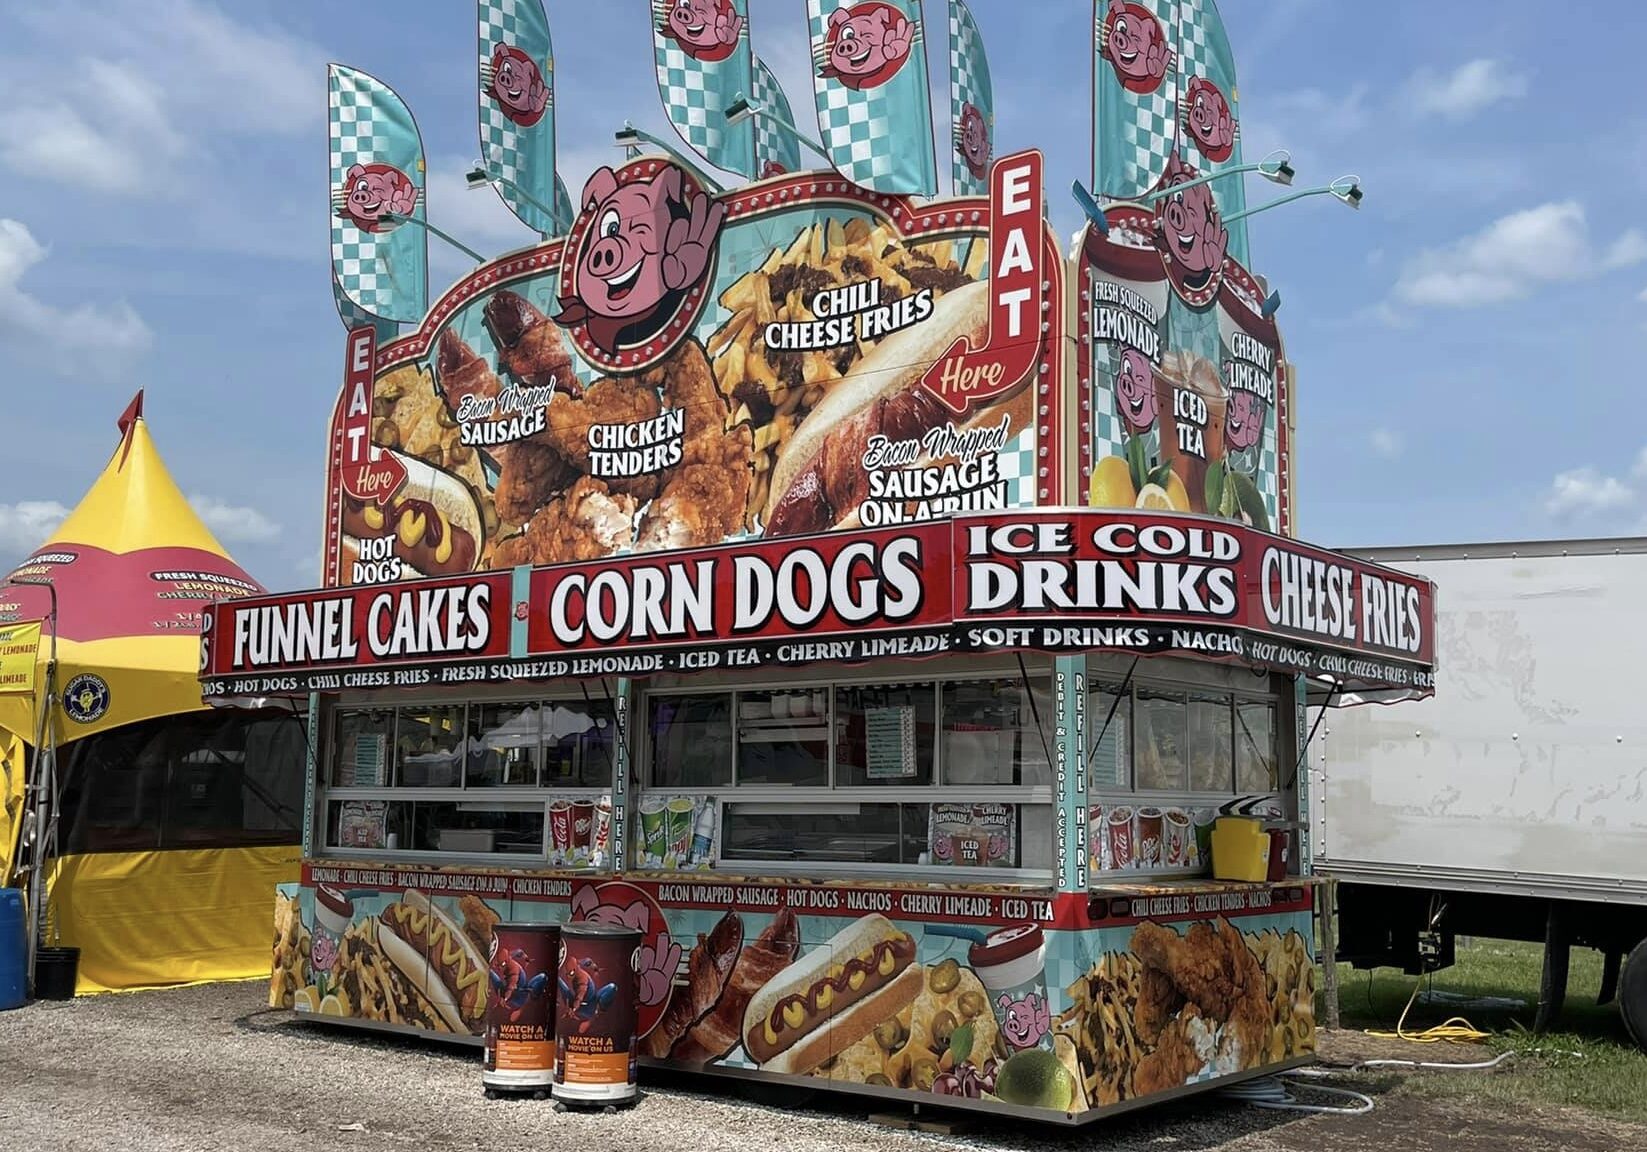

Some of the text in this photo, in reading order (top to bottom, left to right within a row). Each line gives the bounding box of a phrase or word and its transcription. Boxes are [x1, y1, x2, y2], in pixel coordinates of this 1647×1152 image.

[998, 165, 1033, 336] EAT
[812, 278, 881, 317] CHILI
[1096, 282, 1156, 325] FRESH SQUEEZED
[764, 289, 932, 348] CHEESE FRIES
[1094, 307, 1160, 365] LEMONADE
[1232, 333, 1271, 373] CHERRY
[940, 357, 1006, 394] Here
[1230, 364, 1272, 404] LIMEADE
[348, 336, 371, 460] EAT
[457, 377, 556, 423] Bacon Wrapped
[1173, 388, 1207, 425] ICED
[461, 408, 546, 445] SAUSAGE
[588, 409, 685, 449] CHICKEN
[864, 414, 1009, 470] Bacon Wrapped
[1176, 422, 1205, 458] TEA
[589, 439, 682, 477] TENDERS
[869, 452, 998, 498] SAUSAGE
[356, 464, 393, 494] Here
[360, 534, 396, 560] HOT
[968, 523, 1240, 560] ICE COLD
[174, 583, 251, 597] LEMONADE
[353, 557, 401, 584] DOGS
[969, 560, 1236, 614] DRINKS
[552, 538, 920, 643] CORN DOGS
[1262, 547, 1421, 652] CHEESE FRIES
[233, 599, 357, 668] FUNNEL
[368, 584, 489, 656] CAKES
[3, 644, 36, 655] LEMONADE
[234, 680, 259, 692] HOT
[262, 678, 297, 691] DOGS
[308, 676, 340, 690] CHILI
[344, 672, 390, 686] CHEESE
[394, 670, 430, 684] FRIES
[442, 666, 486, 681] FRESH
[490, 658, 568, 679] SQUEEZED
[572, 654, 663, 674] LEMONADE
[679, 652, 720, 668] ICED
[727, 650, 760, 666] TEA
[777, 642, 853, 662] CHERRY
[862, 634, 950, 656] LIMEADE
[968, 628, 1034, 646] SOFT
[1043, 628, 1150, 646] DRINKS
[1252, 642, 1279, 660] HOT
[1280, 648, 1312, 667] DOGS
[1319, 654, 1346, 672] CHILI
[1349, 660, 1383, 679] CHEESE
[1384, 666, 1407, 684] FRIES
[1056, 673, 1066, 887] DEBIT & CREDIT ACCEPTED
[1076, 674, 1086, 888] REFILL HERE
[615, 806, 624, 871] HERE
[961, 840, 979, 850] ICED
[962, 850, 977, 860] TEA
[312, 868, 339, 882] LEMONADE
[344, 869, 358, 882] CHILI
[359, 870, 378, 884] CHEESE
[420, 874, 447, 889] WRAPPED
[513, 879, 541, 894] CHICKEN
[543, 880, 572, 896] TENDERS
[659, 885, 1054, 921] BACON WRAPPED SAUSAGE HOT DOGS NACHOS CHERRY LIMEADE ICED TEA
[1132, 898, 1149, 917] CHILI
[1150, 897, 1172, 916] CHEESE
[1174, 896, 1190, 914] FRIES
[1194, 894, 1220, 912] CHICKEN
[1221, 892, 1244, 911] TENDERS
[500, 1025, 544, 1033] WATCH A
[568, 1036, 613, 1046] WATCH A
